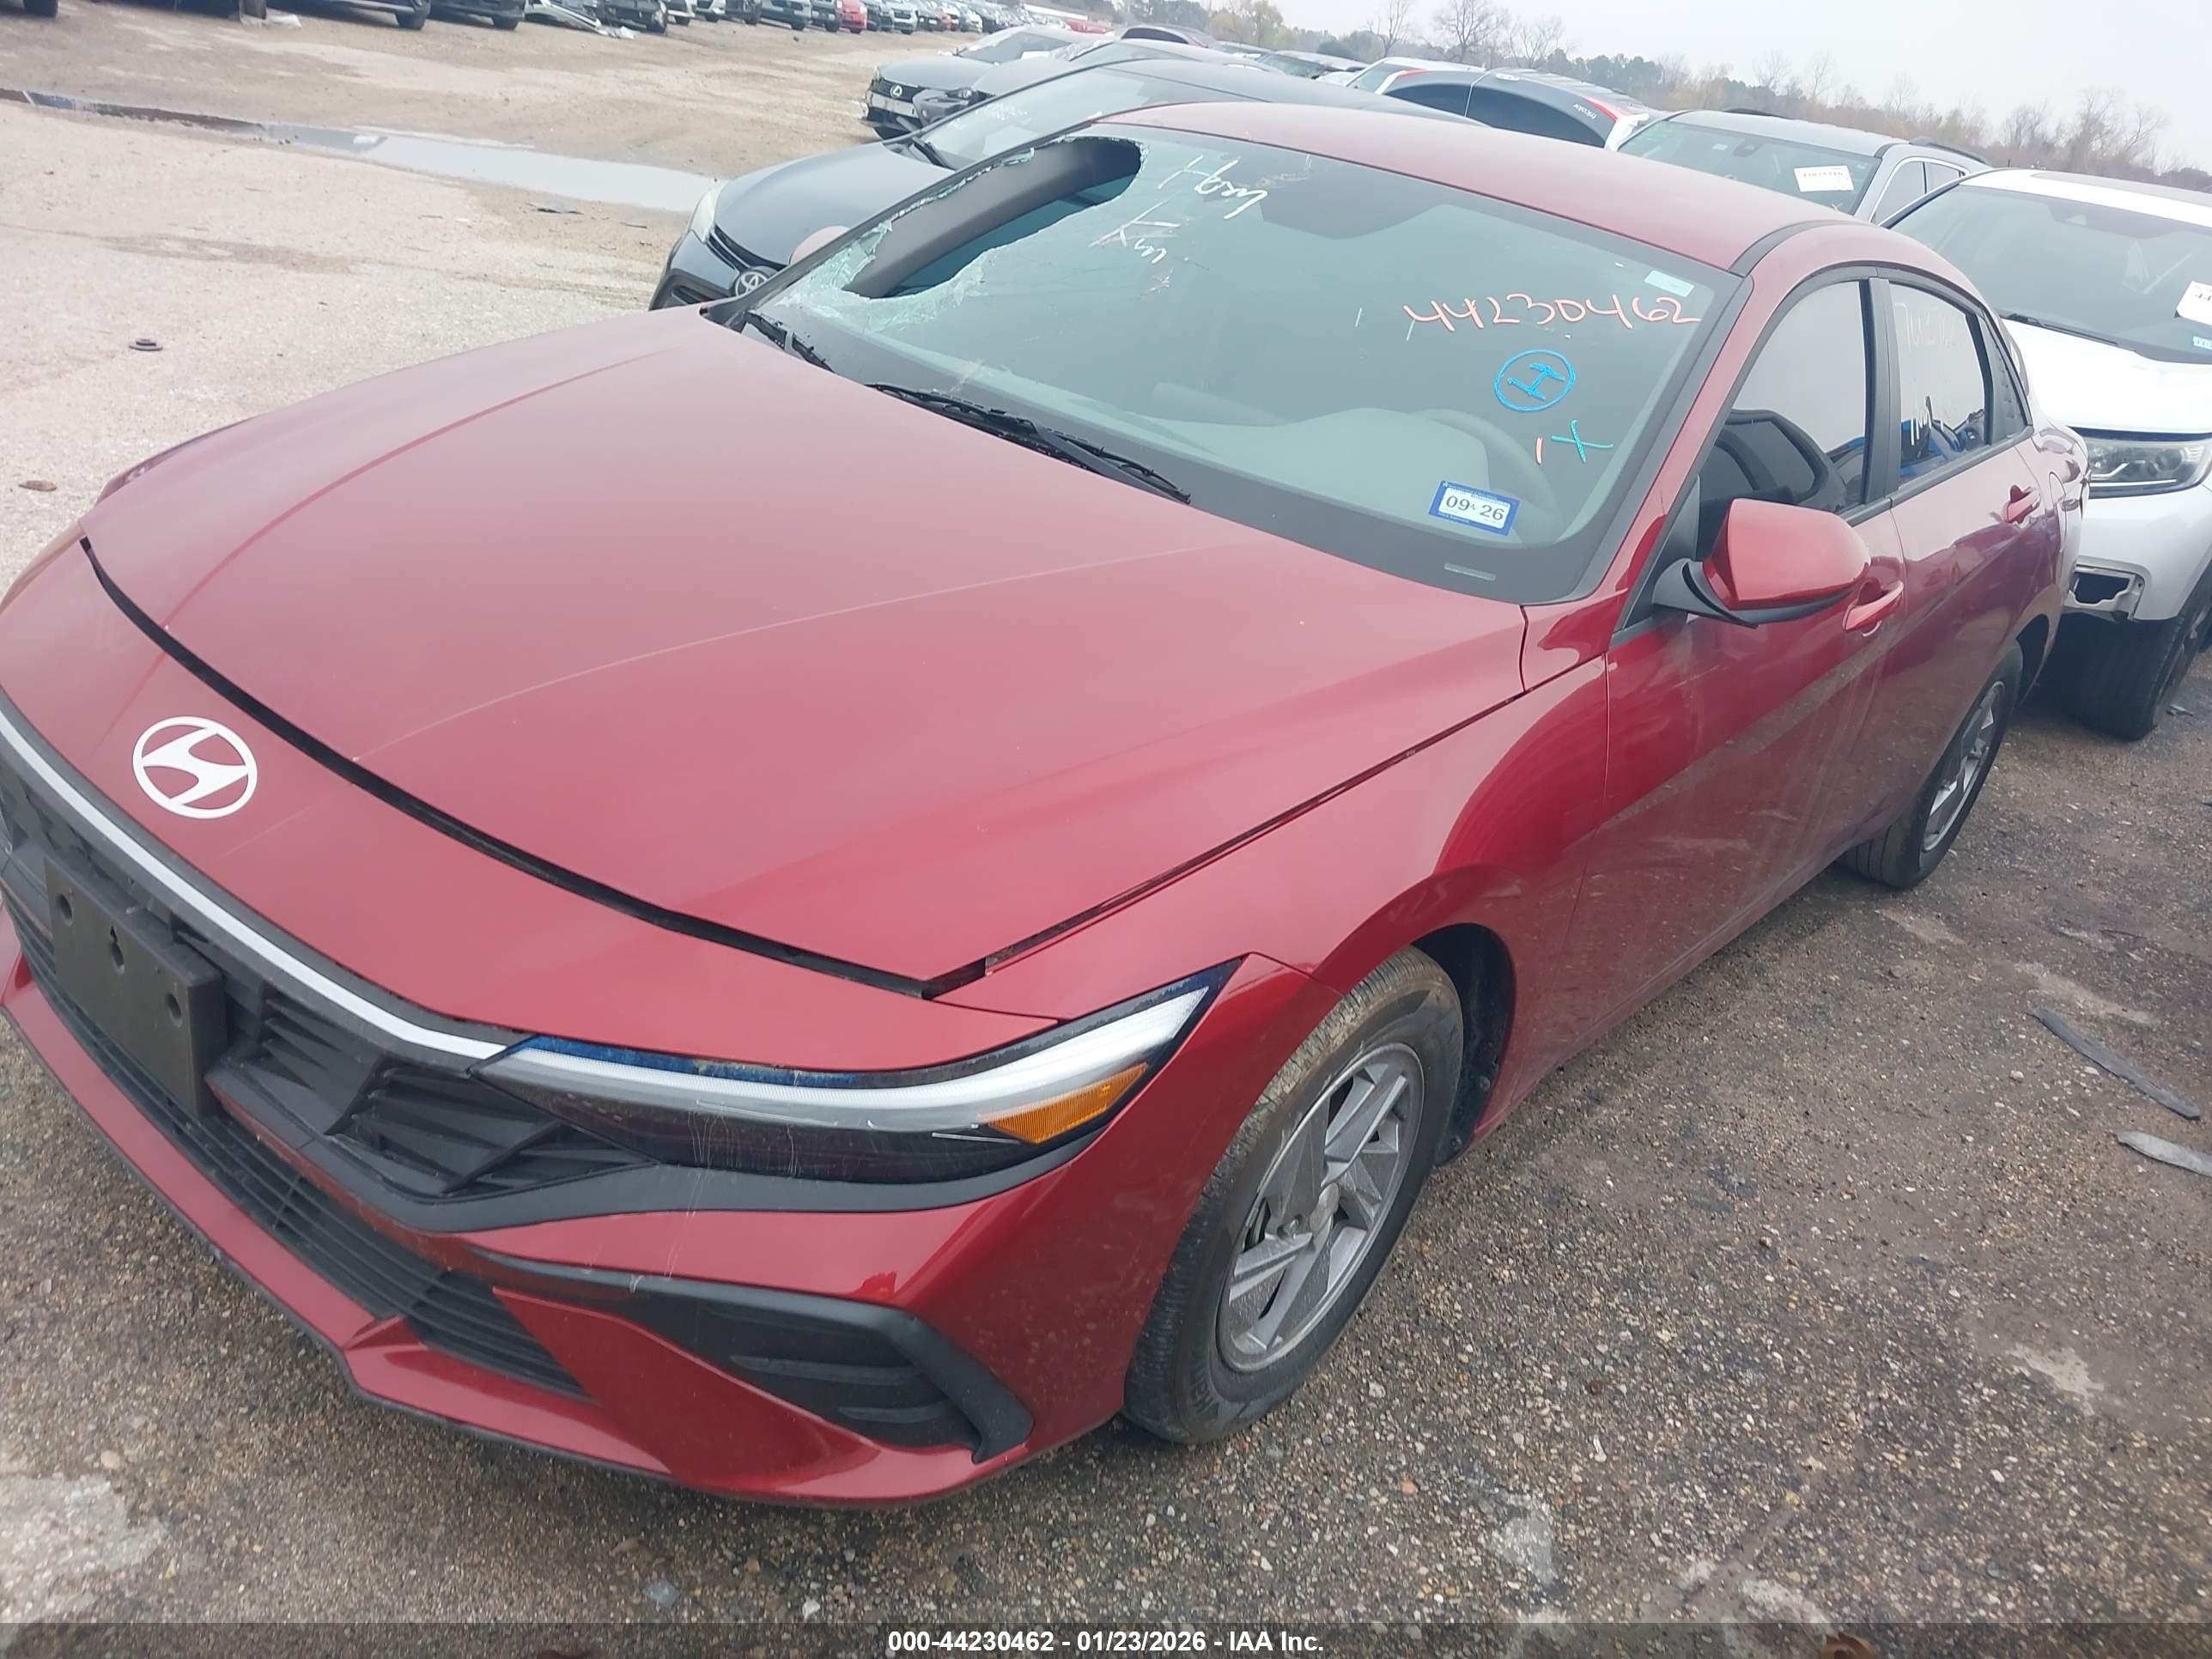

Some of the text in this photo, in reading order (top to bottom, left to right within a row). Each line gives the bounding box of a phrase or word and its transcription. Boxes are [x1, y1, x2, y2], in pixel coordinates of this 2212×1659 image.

[1402, 293, 1703, 332] 44230462
[1445, 495, 1471, 512] 09
[1479, 504, 1506, 521] 26
